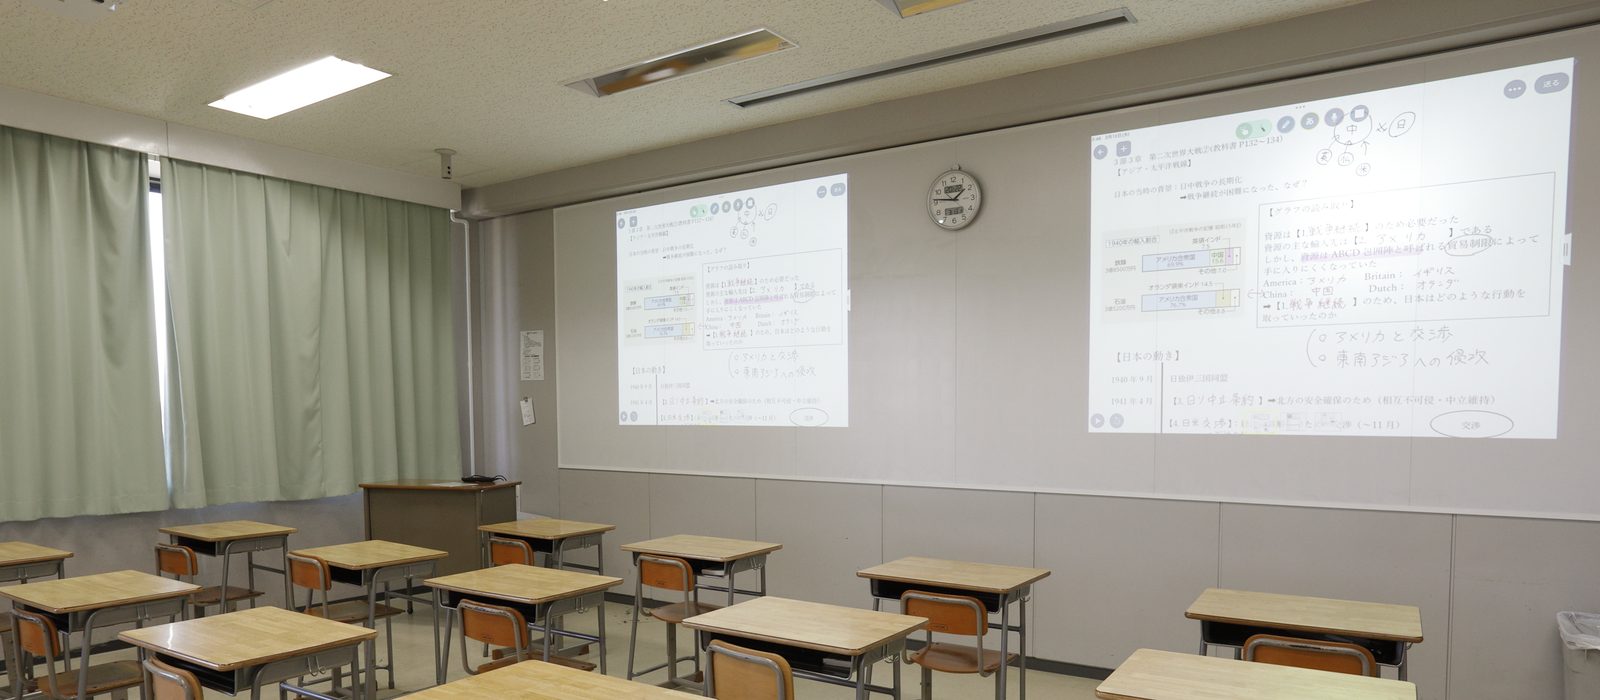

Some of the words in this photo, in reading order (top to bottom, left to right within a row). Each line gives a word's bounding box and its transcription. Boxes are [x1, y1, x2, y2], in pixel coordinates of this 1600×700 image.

[1346, 125, 1358, 135] 中
[1211, 251, 1224, 259] 中国
[1330, 246, 1362, 259] ABCD
[1156, 253, 1196, 264] アメリカ合衆国
[1311, 286, 1335, 297] 中国
[1158, 294, 1199, 303] アメリカ合衆国
[1115, 350, 1180, 364] 【日本の動き】
